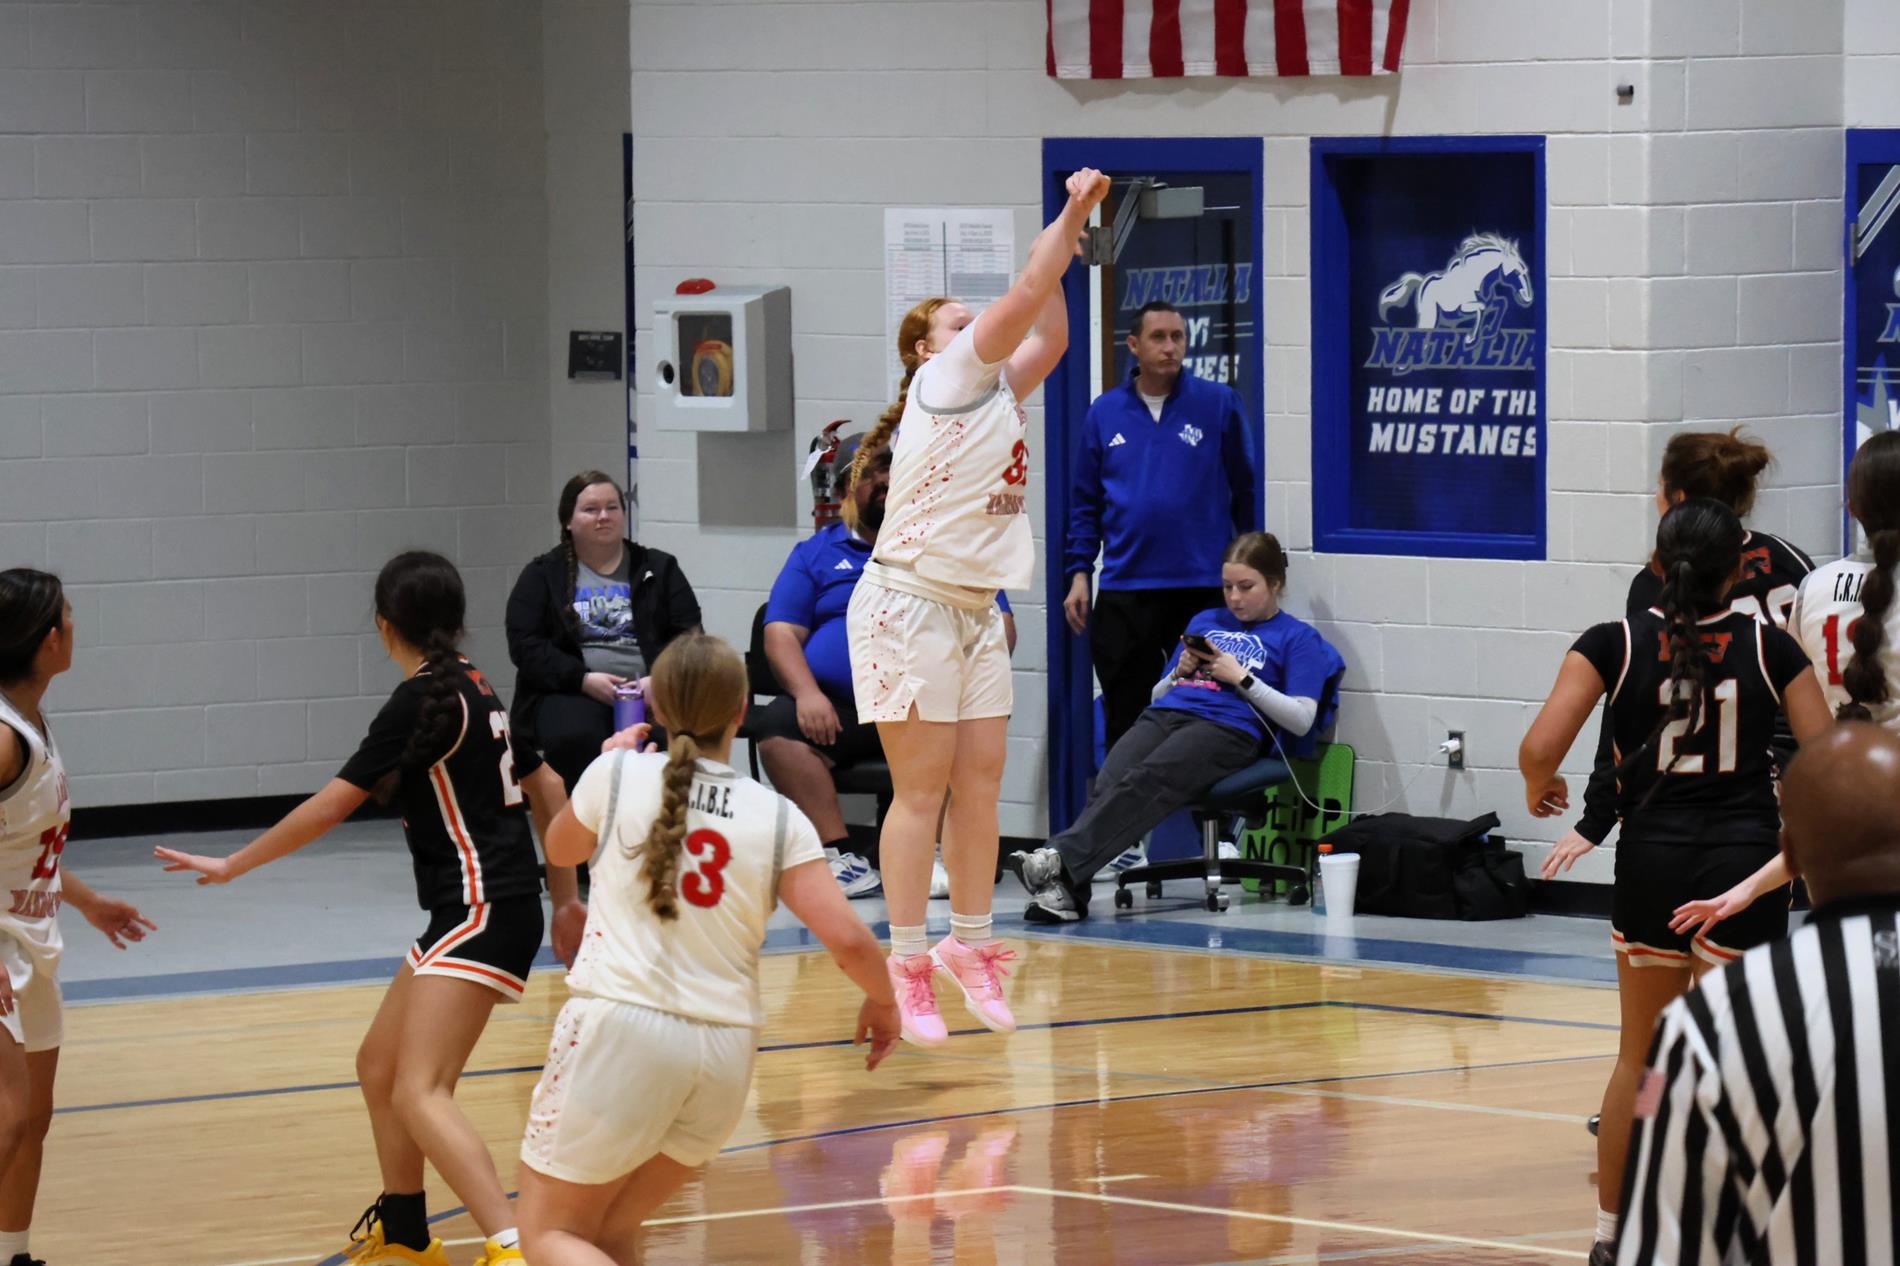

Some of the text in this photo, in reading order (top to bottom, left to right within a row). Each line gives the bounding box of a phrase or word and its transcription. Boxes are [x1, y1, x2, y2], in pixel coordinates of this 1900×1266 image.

[1366, 386, 1443, 414] HOME
[1449, 388, 1485, 415] OF
[1368, 422, 1536, 456] MUSTANGS
[1656, 677, 1738, 774] 21
[682, 827, 732, 908] 3
